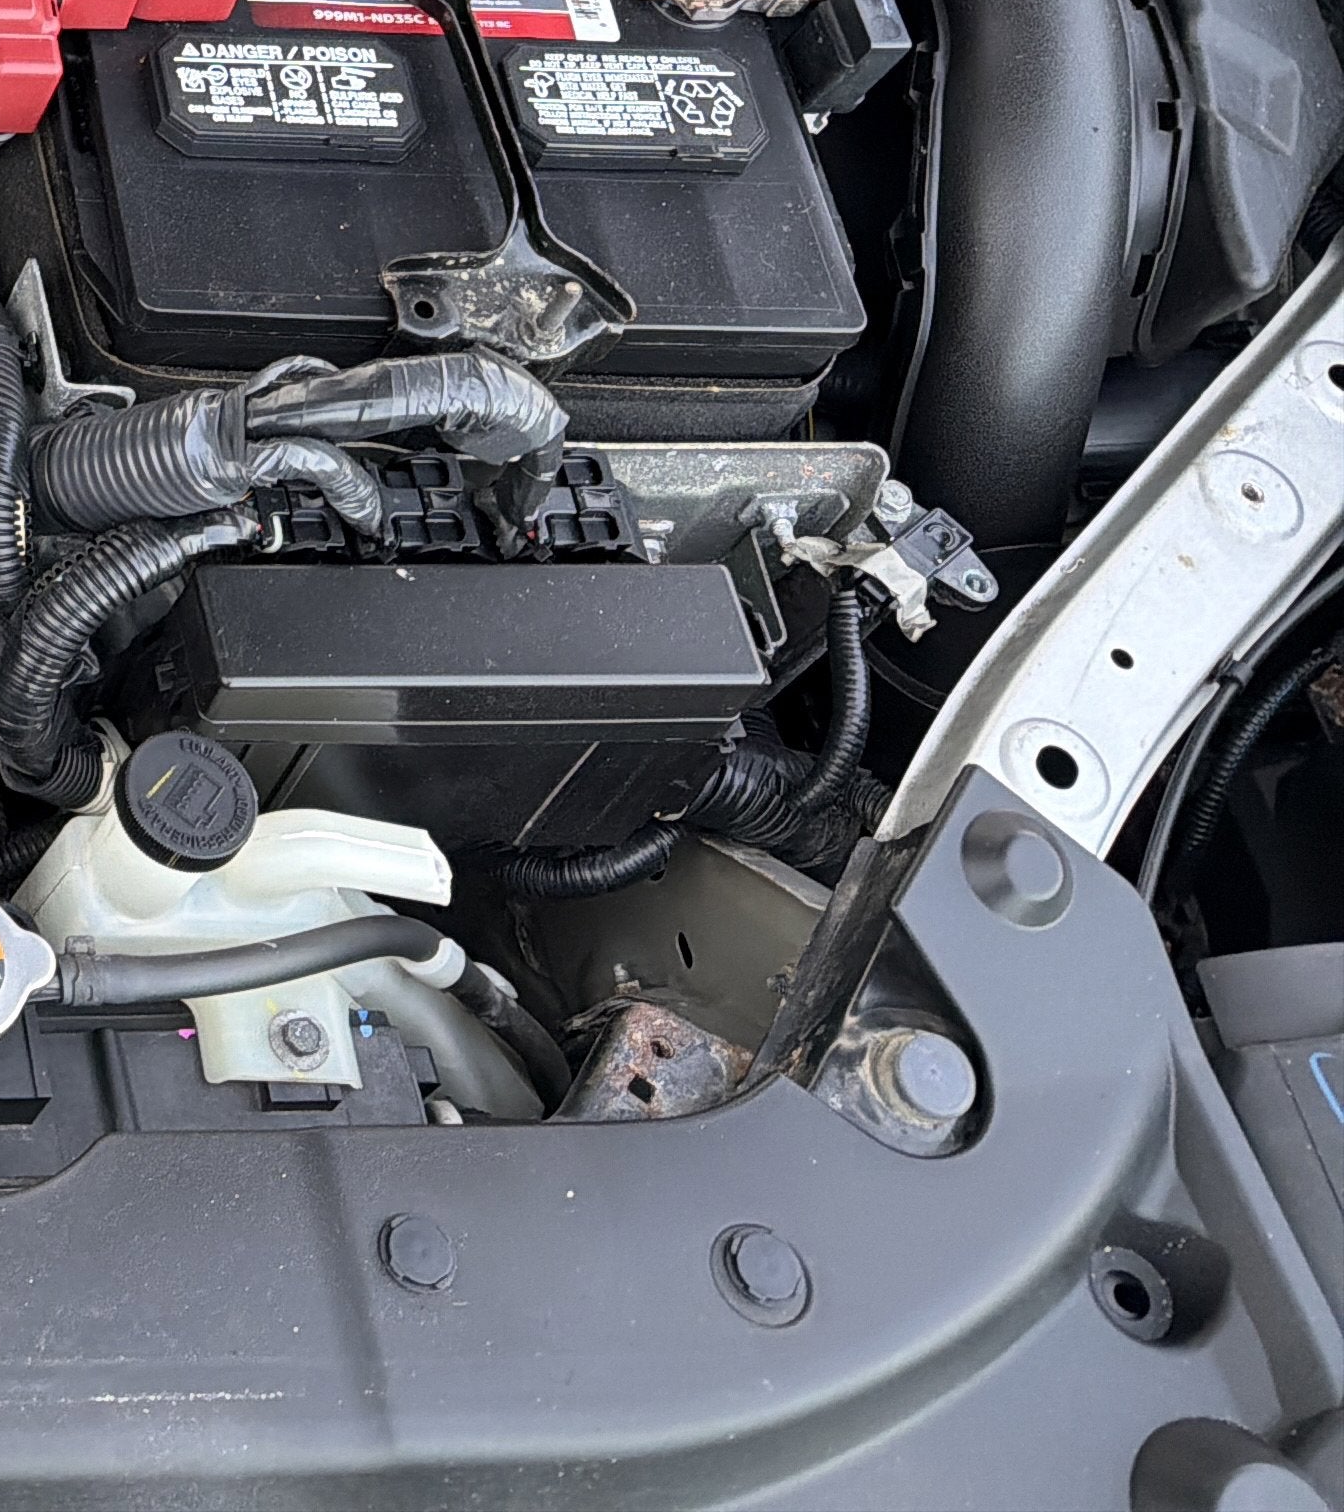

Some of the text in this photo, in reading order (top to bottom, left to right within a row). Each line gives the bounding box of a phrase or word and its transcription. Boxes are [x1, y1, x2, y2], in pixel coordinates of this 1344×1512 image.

[312, 9, 424, 25] 999M1-ND35C
[200, 44, 377, 62] DANGER / POISON
[544, 53, 565, 61] KEEP
[566, 54, 584, 62] OUT
[586, 54, 598, 62] OF
[601, 54, 617, 63] THE
[618, 54, 646, 63] REACH
[647, 55, 659, 63] OF
[543, 60, 561, 68] NOT
[603, 62, 625, 70] VENT
[555, 72, 581, 81] FLUSH
[582, 72, 604, 82] EYES
[231, 78, 259, 87] EYES
[288, 89, 308, 99] NO
